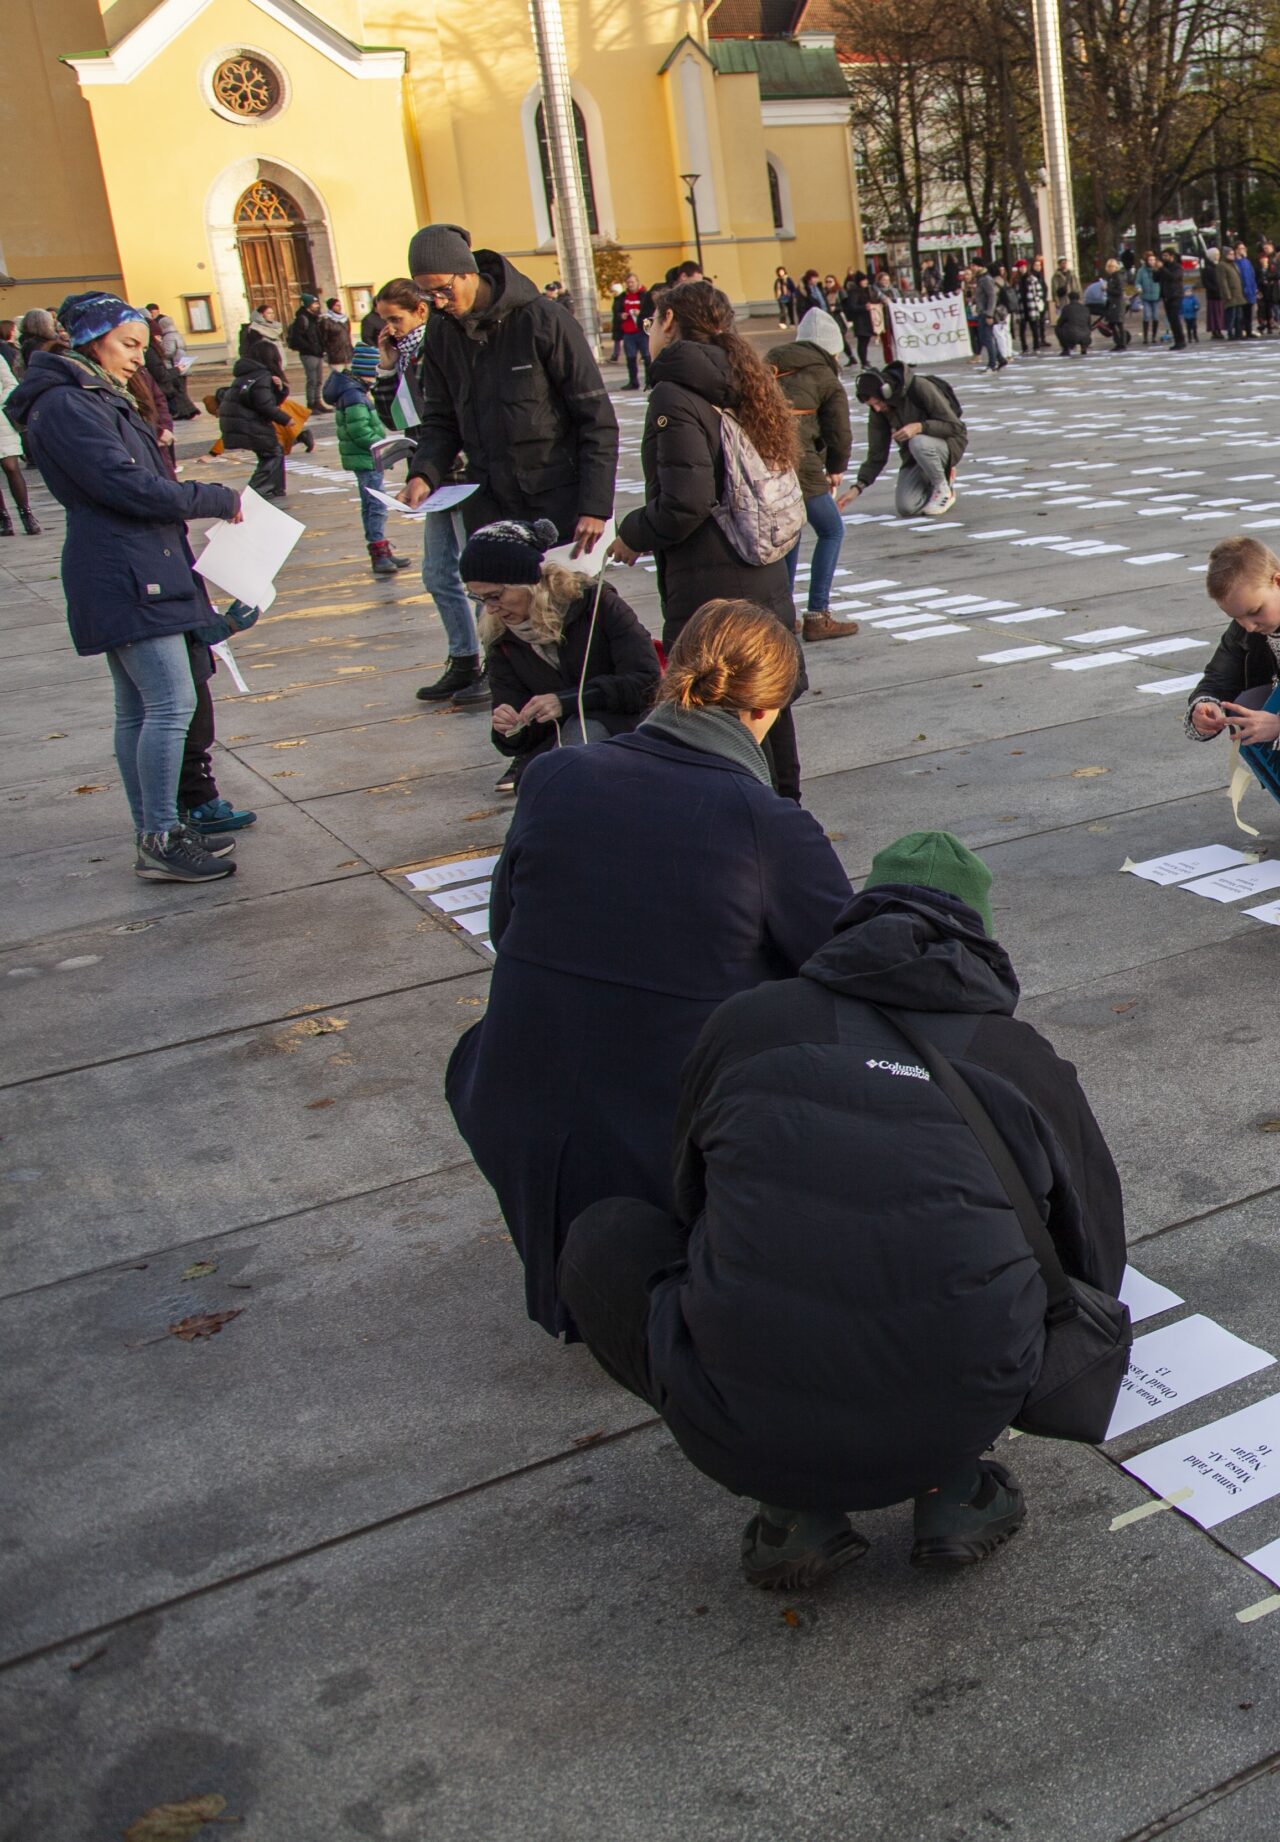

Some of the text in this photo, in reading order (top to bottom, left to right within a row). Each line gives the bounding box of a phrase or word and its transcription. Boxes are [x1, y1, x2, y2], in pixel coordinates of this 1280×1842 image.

[894, 303, 961, 325] END THE
[878, 1060, 930, 1075] Columbia
[1129, 1363, 1178, 1399] Obaid Yass
[1155, 1367, 1172, 1377] 13
[1136, 1387, 1162, 1407] Roaa
[1230, 1447, 1267, 1471] Najjar
[1256, 1444, 1272, 1456] 16
[1182, 1455, 1242, 1495] Sama Fahd
[1225, 1461, 1255, 1483] Musa
